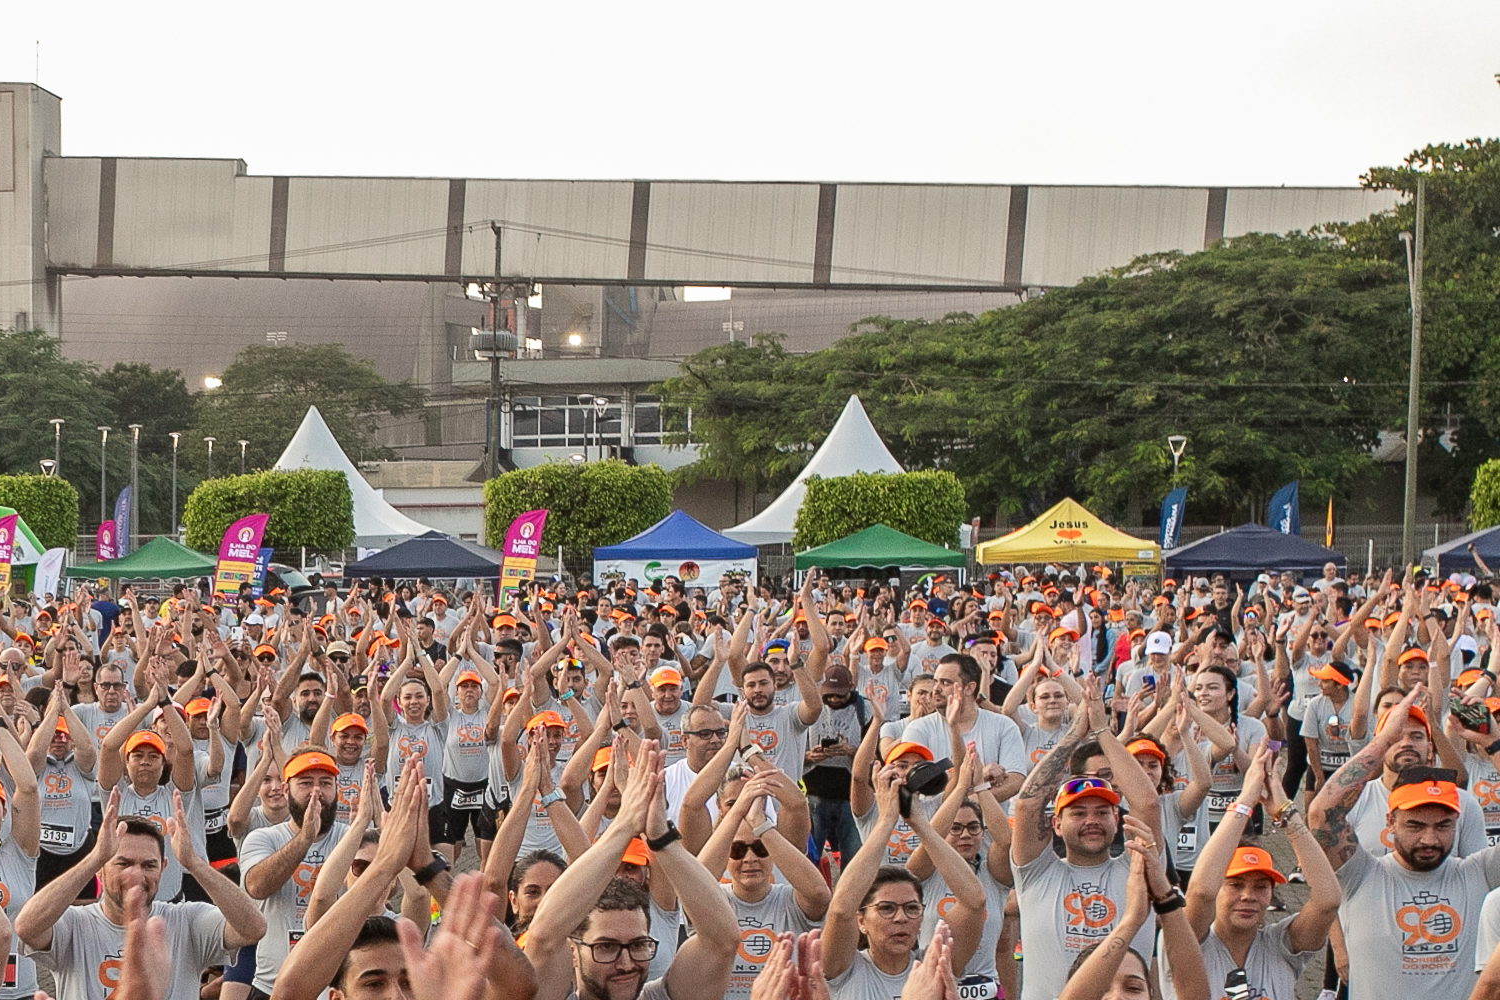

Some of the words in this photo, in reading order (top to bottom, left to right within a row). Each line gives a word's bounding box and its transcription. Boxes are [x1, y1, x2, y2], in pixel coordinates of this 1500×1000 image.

[1050, 520, 1088, 529] Jesus
[45, 774, 72, 793] 90
[43, 830, 67, 841] 5139
[1064, 892, 1117, 928] 90
[1071, 926, 1109, 934] ANOS
[1395, 904, 1462, 946] 90
[1406, 943, 1454, 952] ANOS
